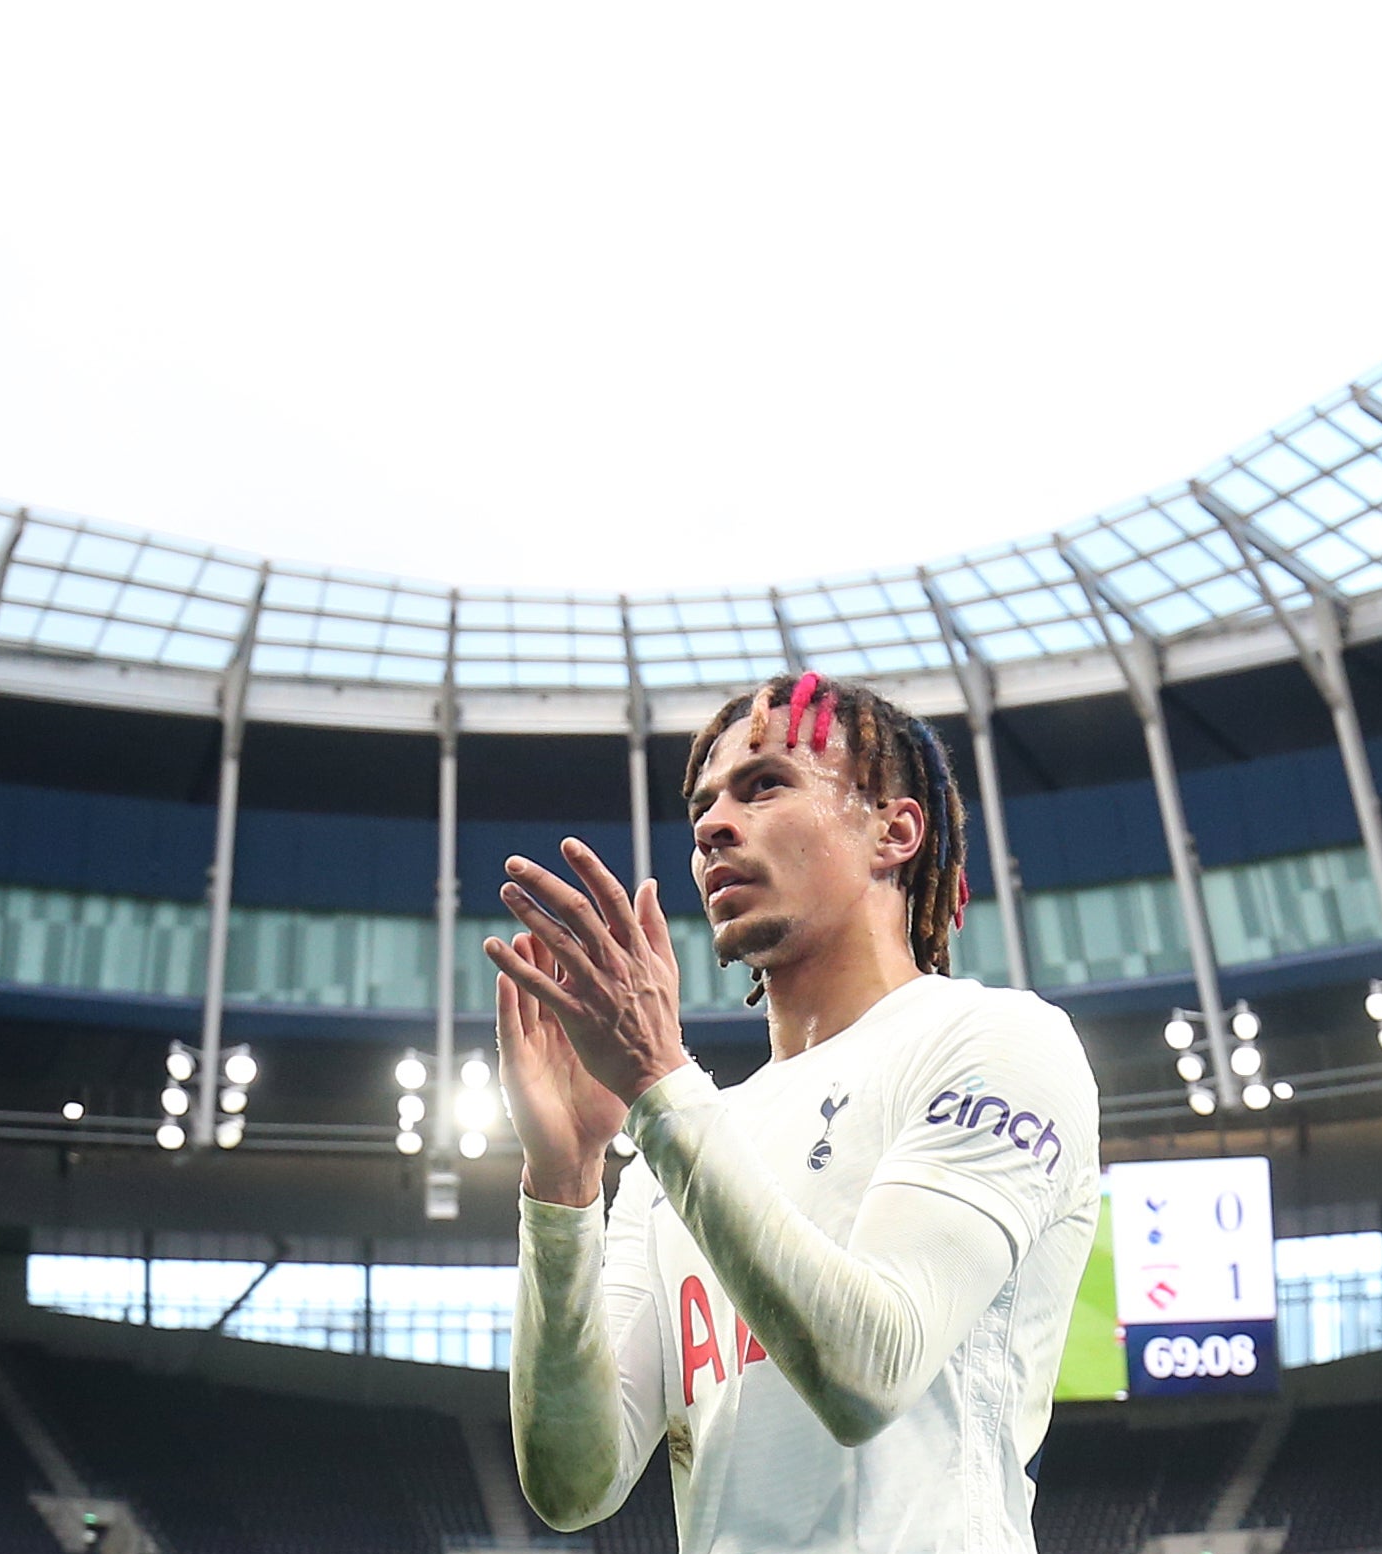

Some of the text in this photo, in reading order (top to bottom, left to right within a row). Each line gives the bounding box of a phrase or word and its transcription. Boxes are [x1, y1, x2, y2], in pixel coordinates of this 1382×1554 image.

[925, 1076, 1062, 1176] cinch
[1215, 1191, 1243, 1232] 0
[1229, 1262, 1242, 1301] 1
